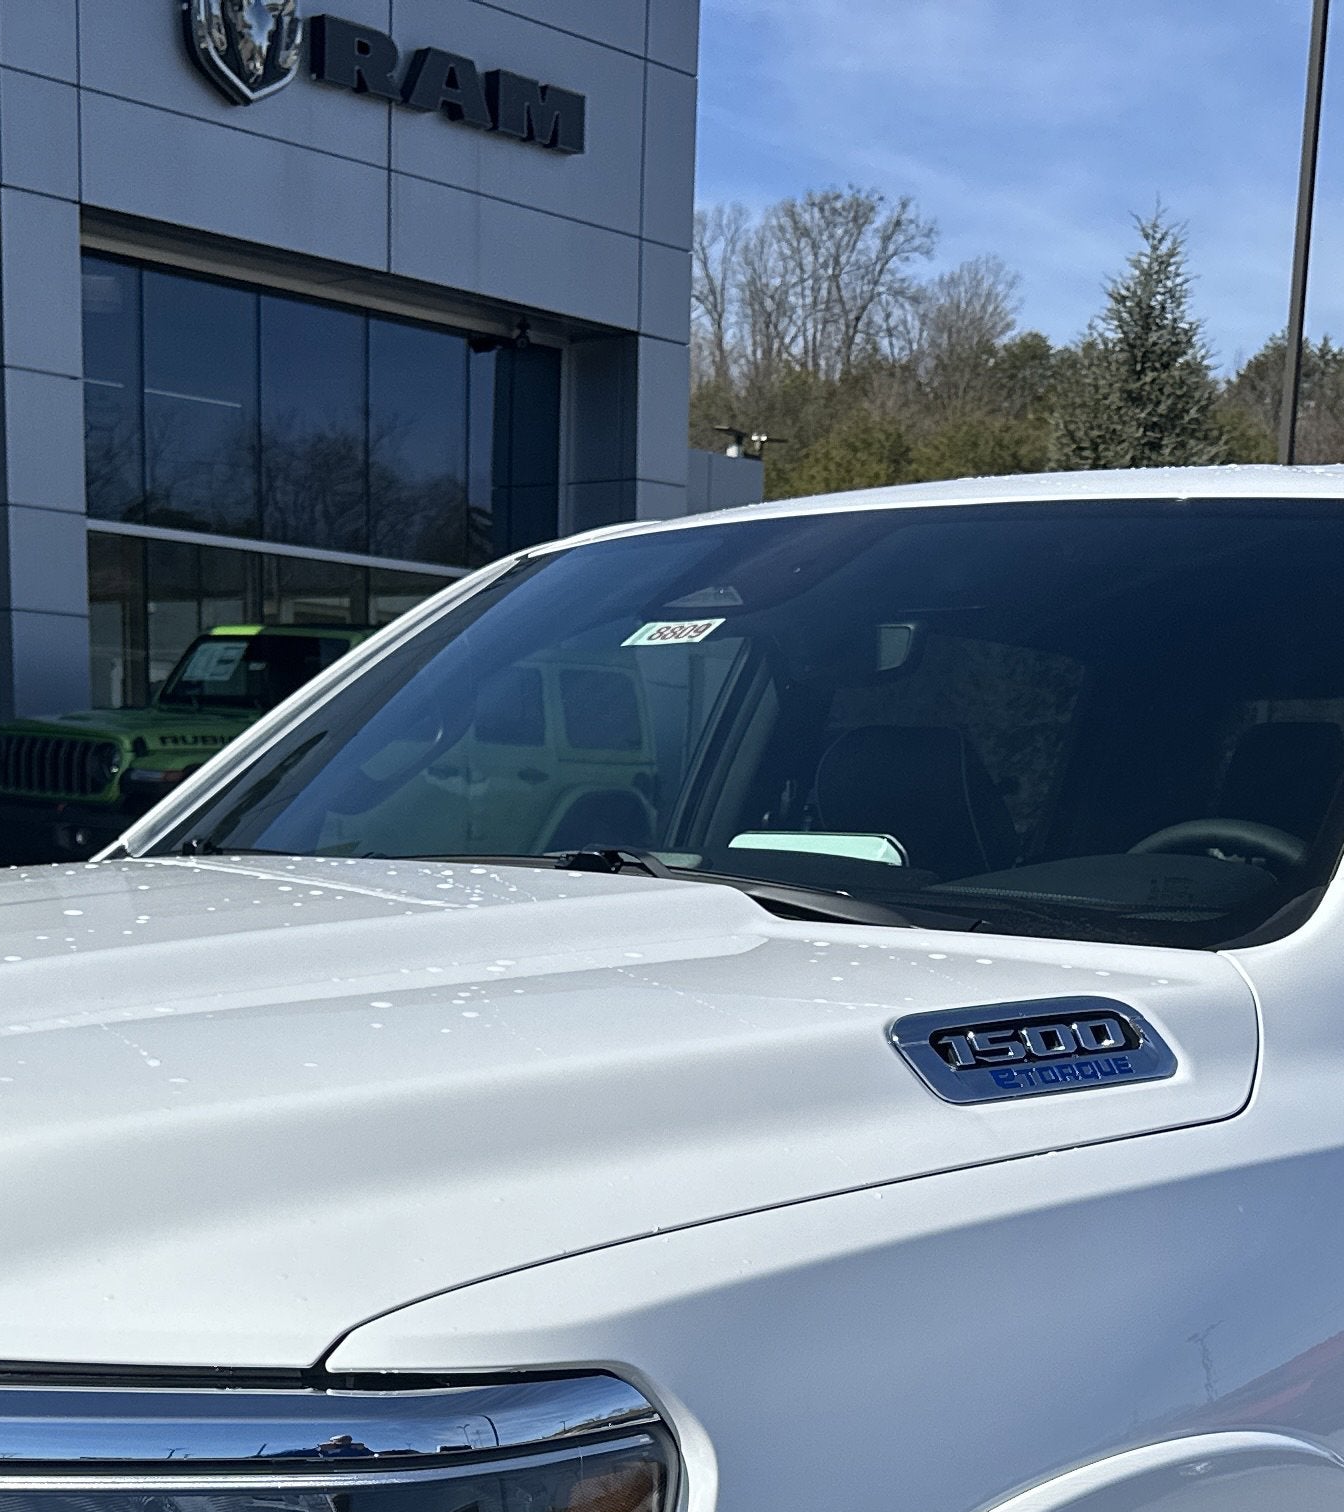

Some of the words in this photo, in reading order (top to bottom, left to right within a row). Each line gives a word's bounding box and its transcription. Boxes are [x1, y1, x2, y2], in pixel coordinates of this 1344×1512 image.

[309, 13, 586, 155] RAM
[646, 622, 712, 641] 8809
[938, 1018, 1126, 1066] 1500
